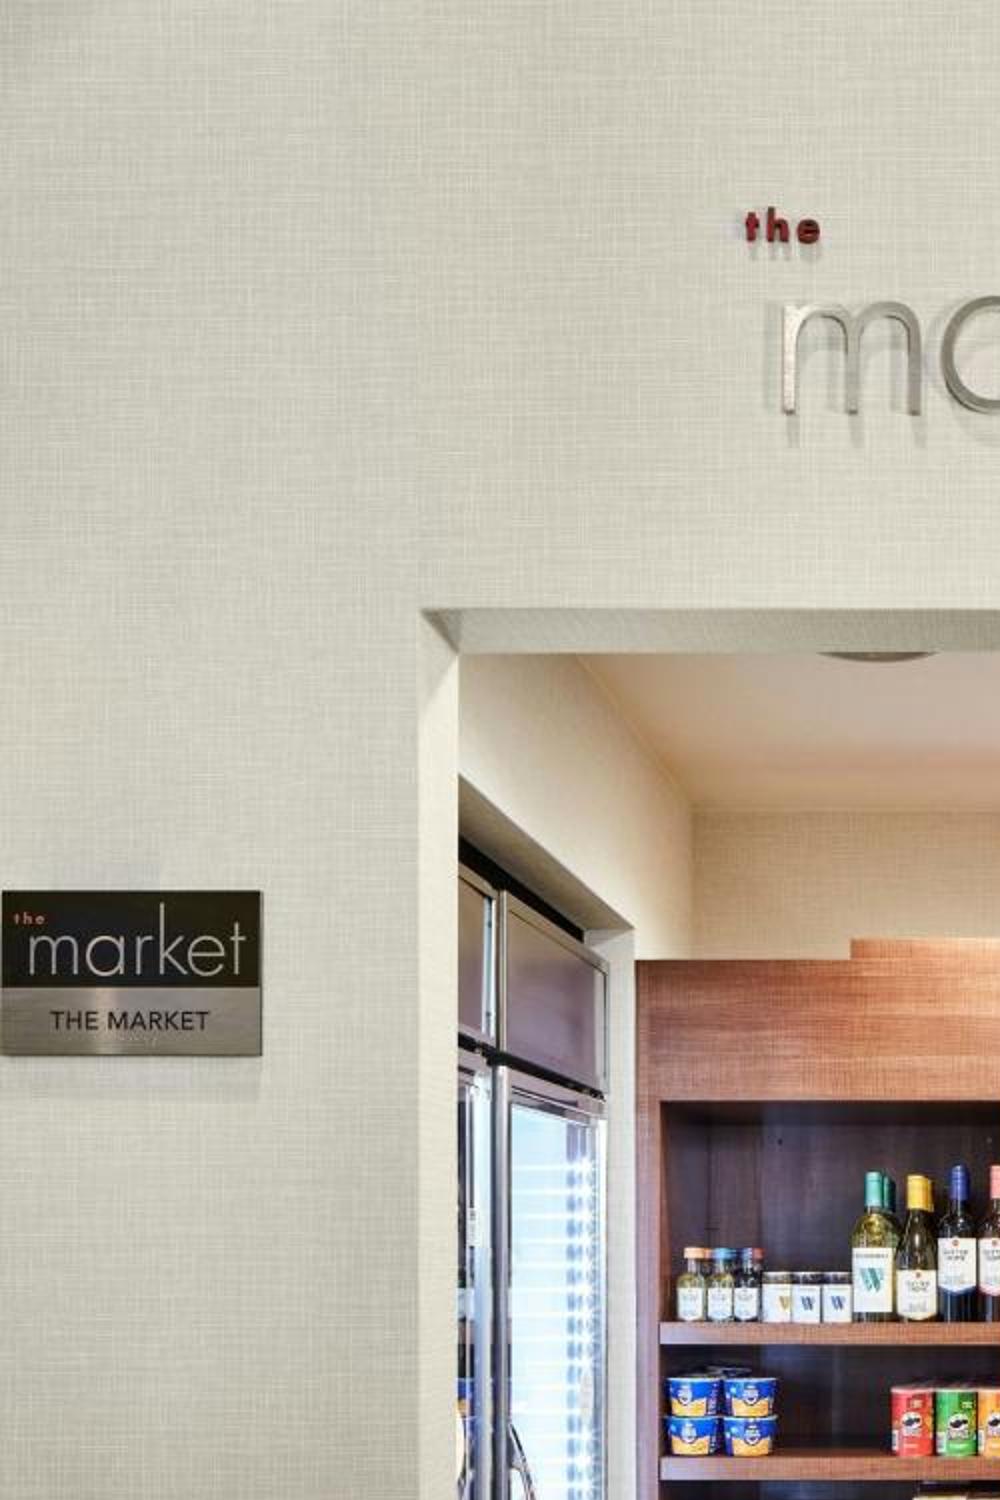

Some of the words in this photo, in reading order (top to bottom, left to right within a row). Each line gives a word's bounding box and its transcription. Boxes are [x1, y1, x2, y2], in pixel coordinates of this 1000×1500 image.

[744, 206, 821, 244] the
[14, 912, 46, 926] the
[29, 902, 247, 977] market
[50, 1010, 99, 1032] THE
[107, 1010, 210, 1032] MARKET
